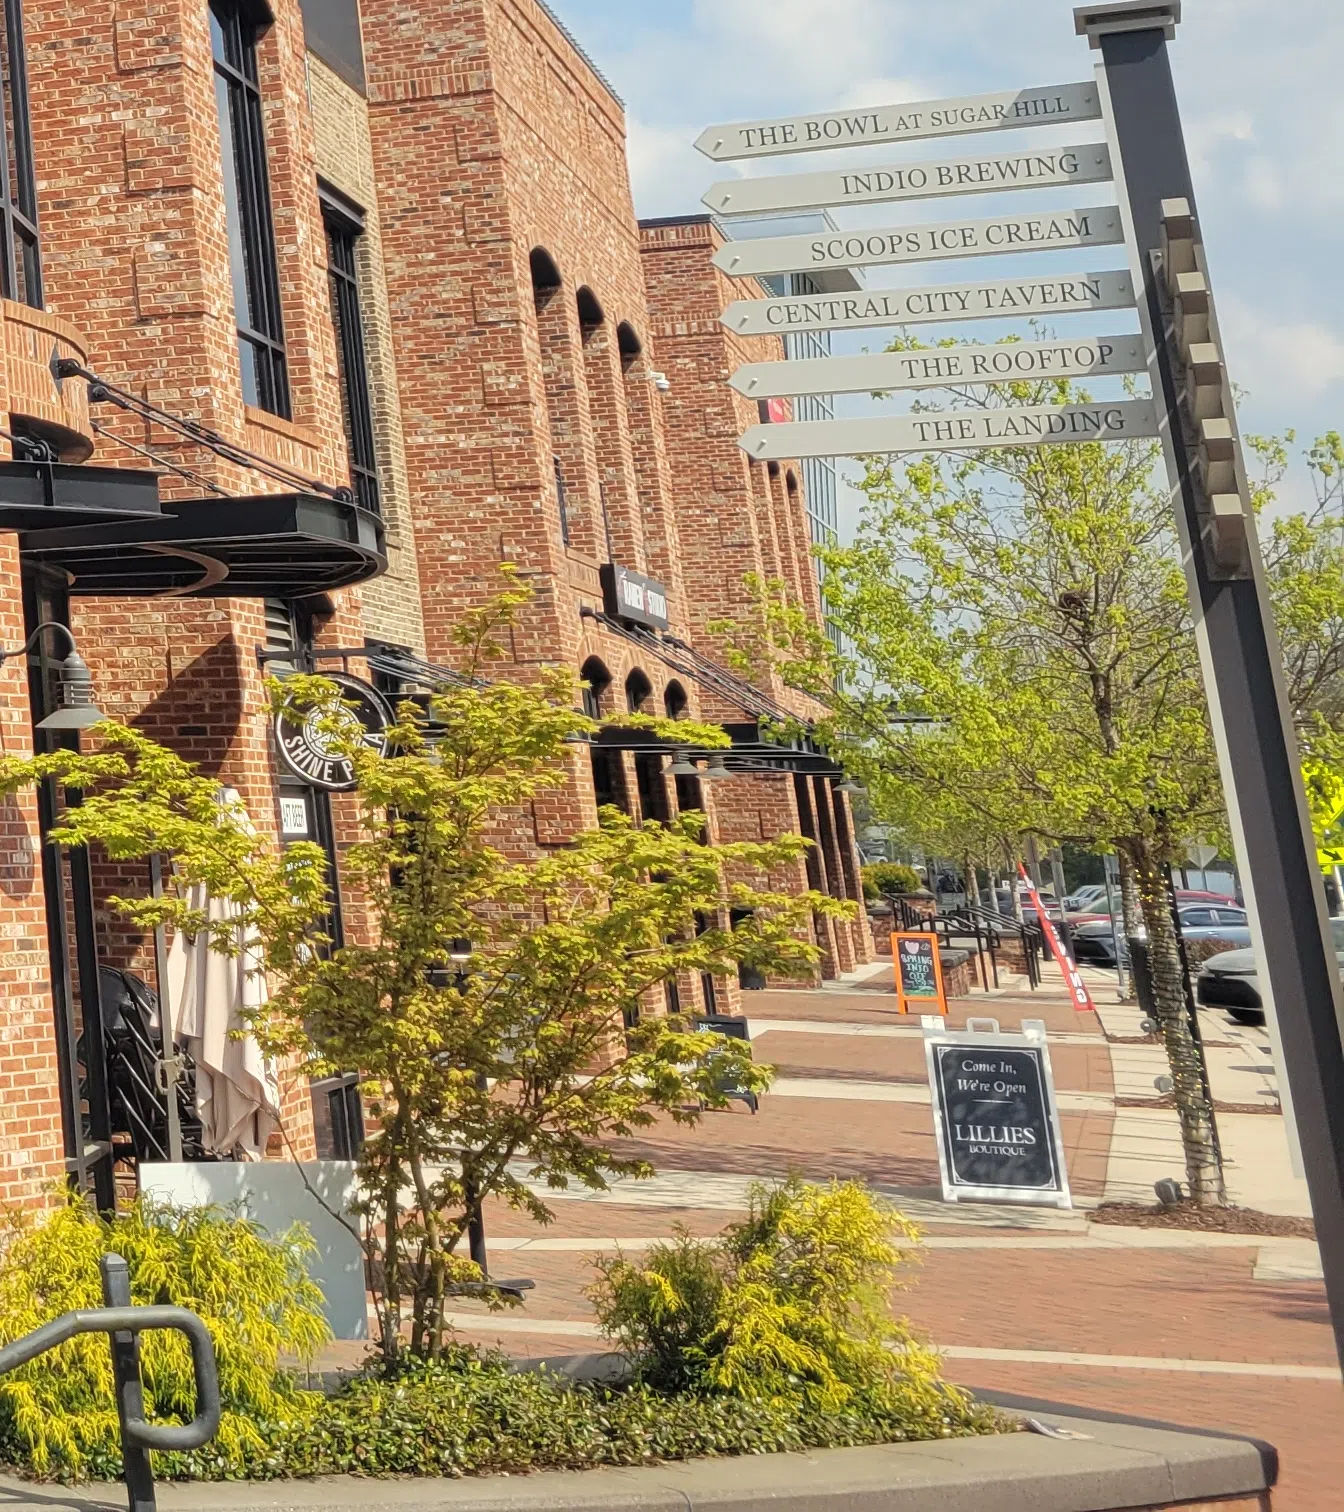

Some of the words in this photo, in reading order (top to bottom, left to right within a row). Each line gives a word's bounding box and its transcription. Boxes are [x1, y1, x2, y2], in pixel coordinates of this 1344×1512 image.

[739, 124, 798, 148] THE
[804, 114, 888, 141] BOWL
[895, 113, 923, 131] AT
[930, 104, 1008, 127] SUGAR
[1013, 96, 1070, 117] HILL
[840, 168, 927, 195] INDIO
[935, 153, 1079, 186] BREWING
[811, 232, 921, 262] SCOOPS
[927, 226, 978, 251] ICE
[985, 216, 1093, 245] CREAM
[766, 296, 899, 325] CENTRAL
[905, 290, 972, 315] CITY
[978, 279, 1102, 308] TAVERN
[901, 356, 963, 380] THE
[970, 344, 1114, 375] ROOFTOP
[912, 418, 976, 442] THE
[983, 409, 1126, 438] LANDING
[285, 735, 335, 781] SHINE
[962, 1059, 997, 1073] Come
[999, 1060, 1017, 1075] In,
[957, 1078, 990, 1093] We're
[993, 1080, 1027, 1097] Open
[955, 1123, 1036, 1145] LILLIES
[969, 1144, 1026, 1156] BOUTIQUE
